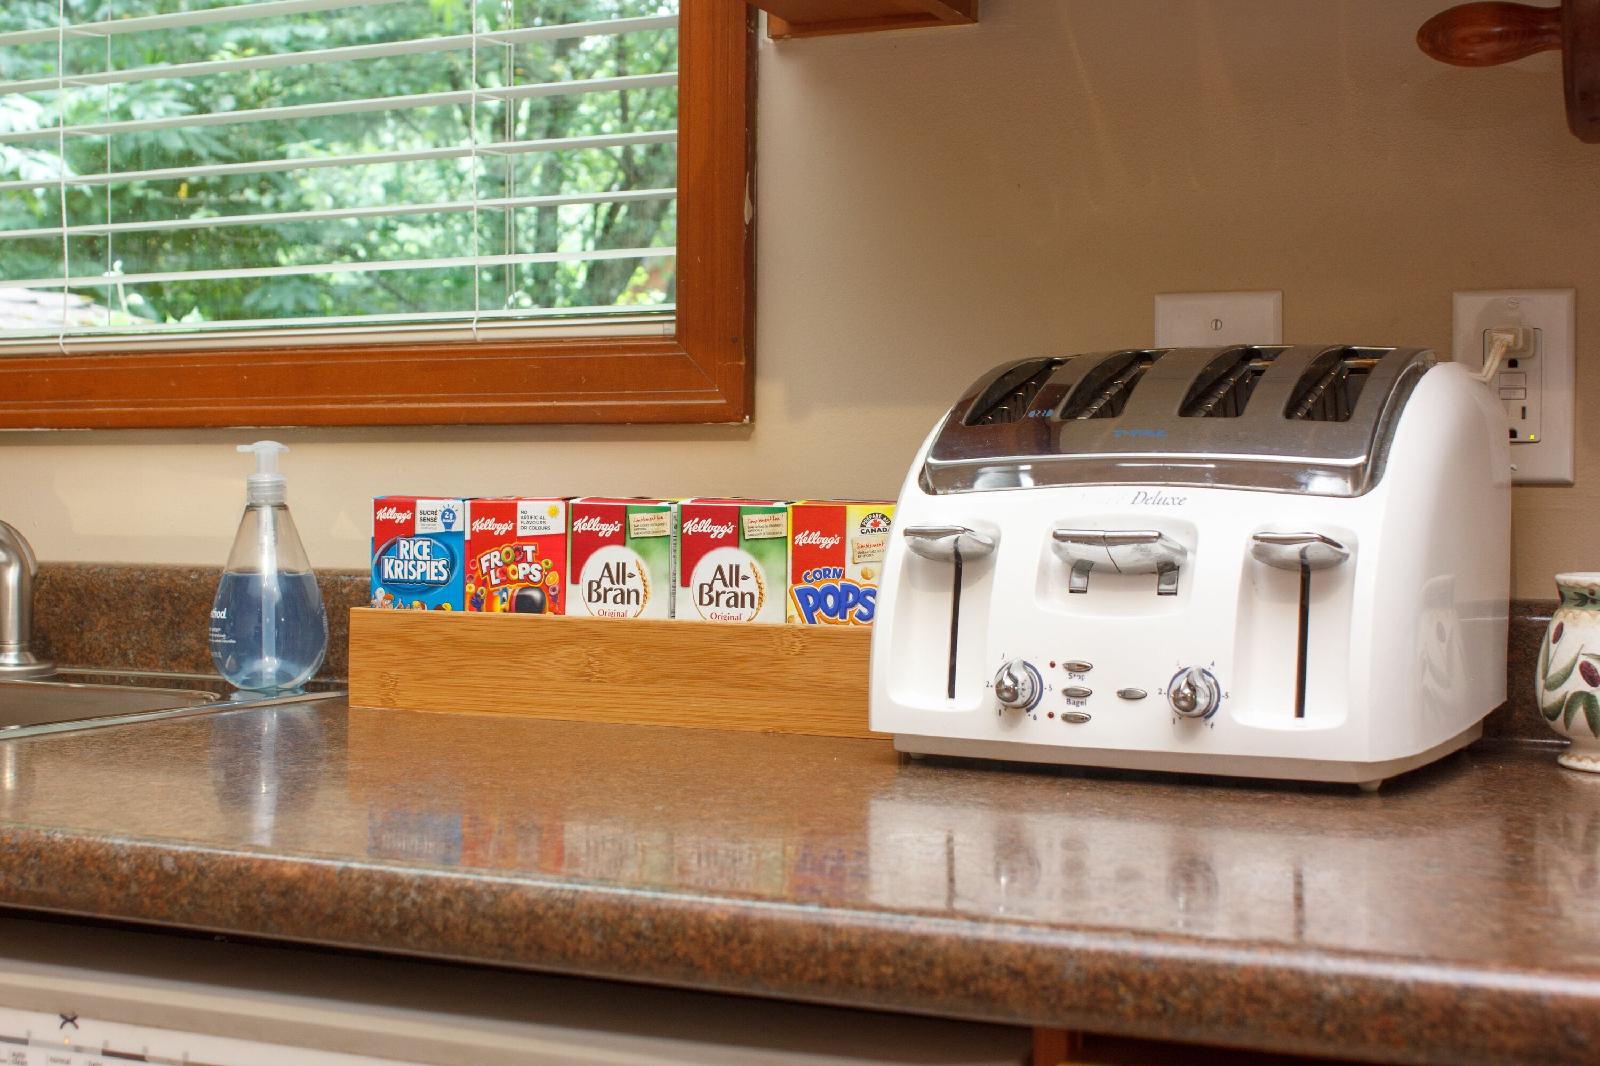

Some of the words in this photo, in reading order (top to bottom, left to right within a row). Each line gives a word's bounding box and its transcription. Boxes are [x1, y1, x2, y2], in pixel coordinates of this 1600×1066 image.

[1131, 490, 1187, 506] Deluxe
[376, 506, 412, 524] Kellogg's
[472, 517, 514, 535] Kellogg's
[572, 515, 622, 537] Kellogg's
[682, 517, 735, 539] Kellogg's
[399, 539, 432, 560] RICE
[794, 530, 841, 549] Kellogg's
[383, 558, 448, 581] KRISPIES
[480, 545, 536, 575] FROOT
[490, 563, 543, 586] LOOPS
[803, 567, 844, 584] CORN
[587, 579, 640, 606] Bran
[698, 583, 756, 609] Bran
[597, 608, 628, 619] Original
[794, 583, 878, 625] POPS
[710, 611, 742, 622] Original
[1066, 698, 1087, 708] Bagel
